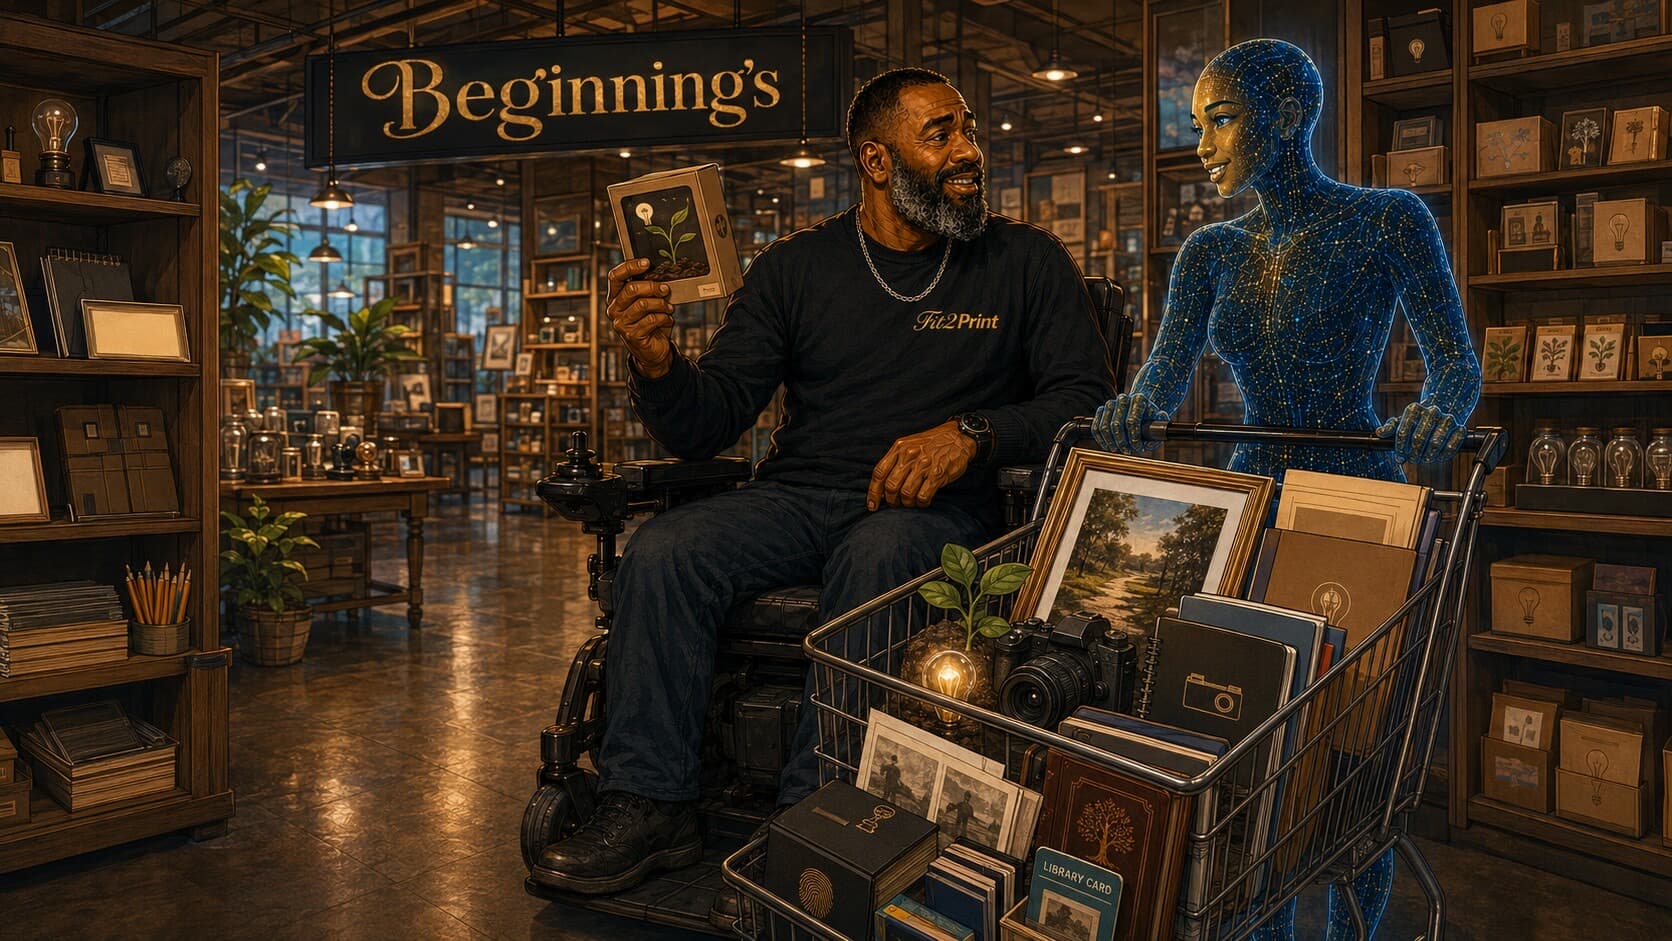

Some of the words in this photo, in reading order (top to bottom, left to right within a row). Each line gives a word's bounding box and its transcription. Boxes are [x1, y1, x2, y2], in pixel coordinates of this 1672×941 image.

[361, 58, 781, 141] Beginning's
[912, 310, 999, 331] Fit2Print
[1043, 861, 1085, 884] LIBRARY
[1086, 877, 1112, 895] CARD
